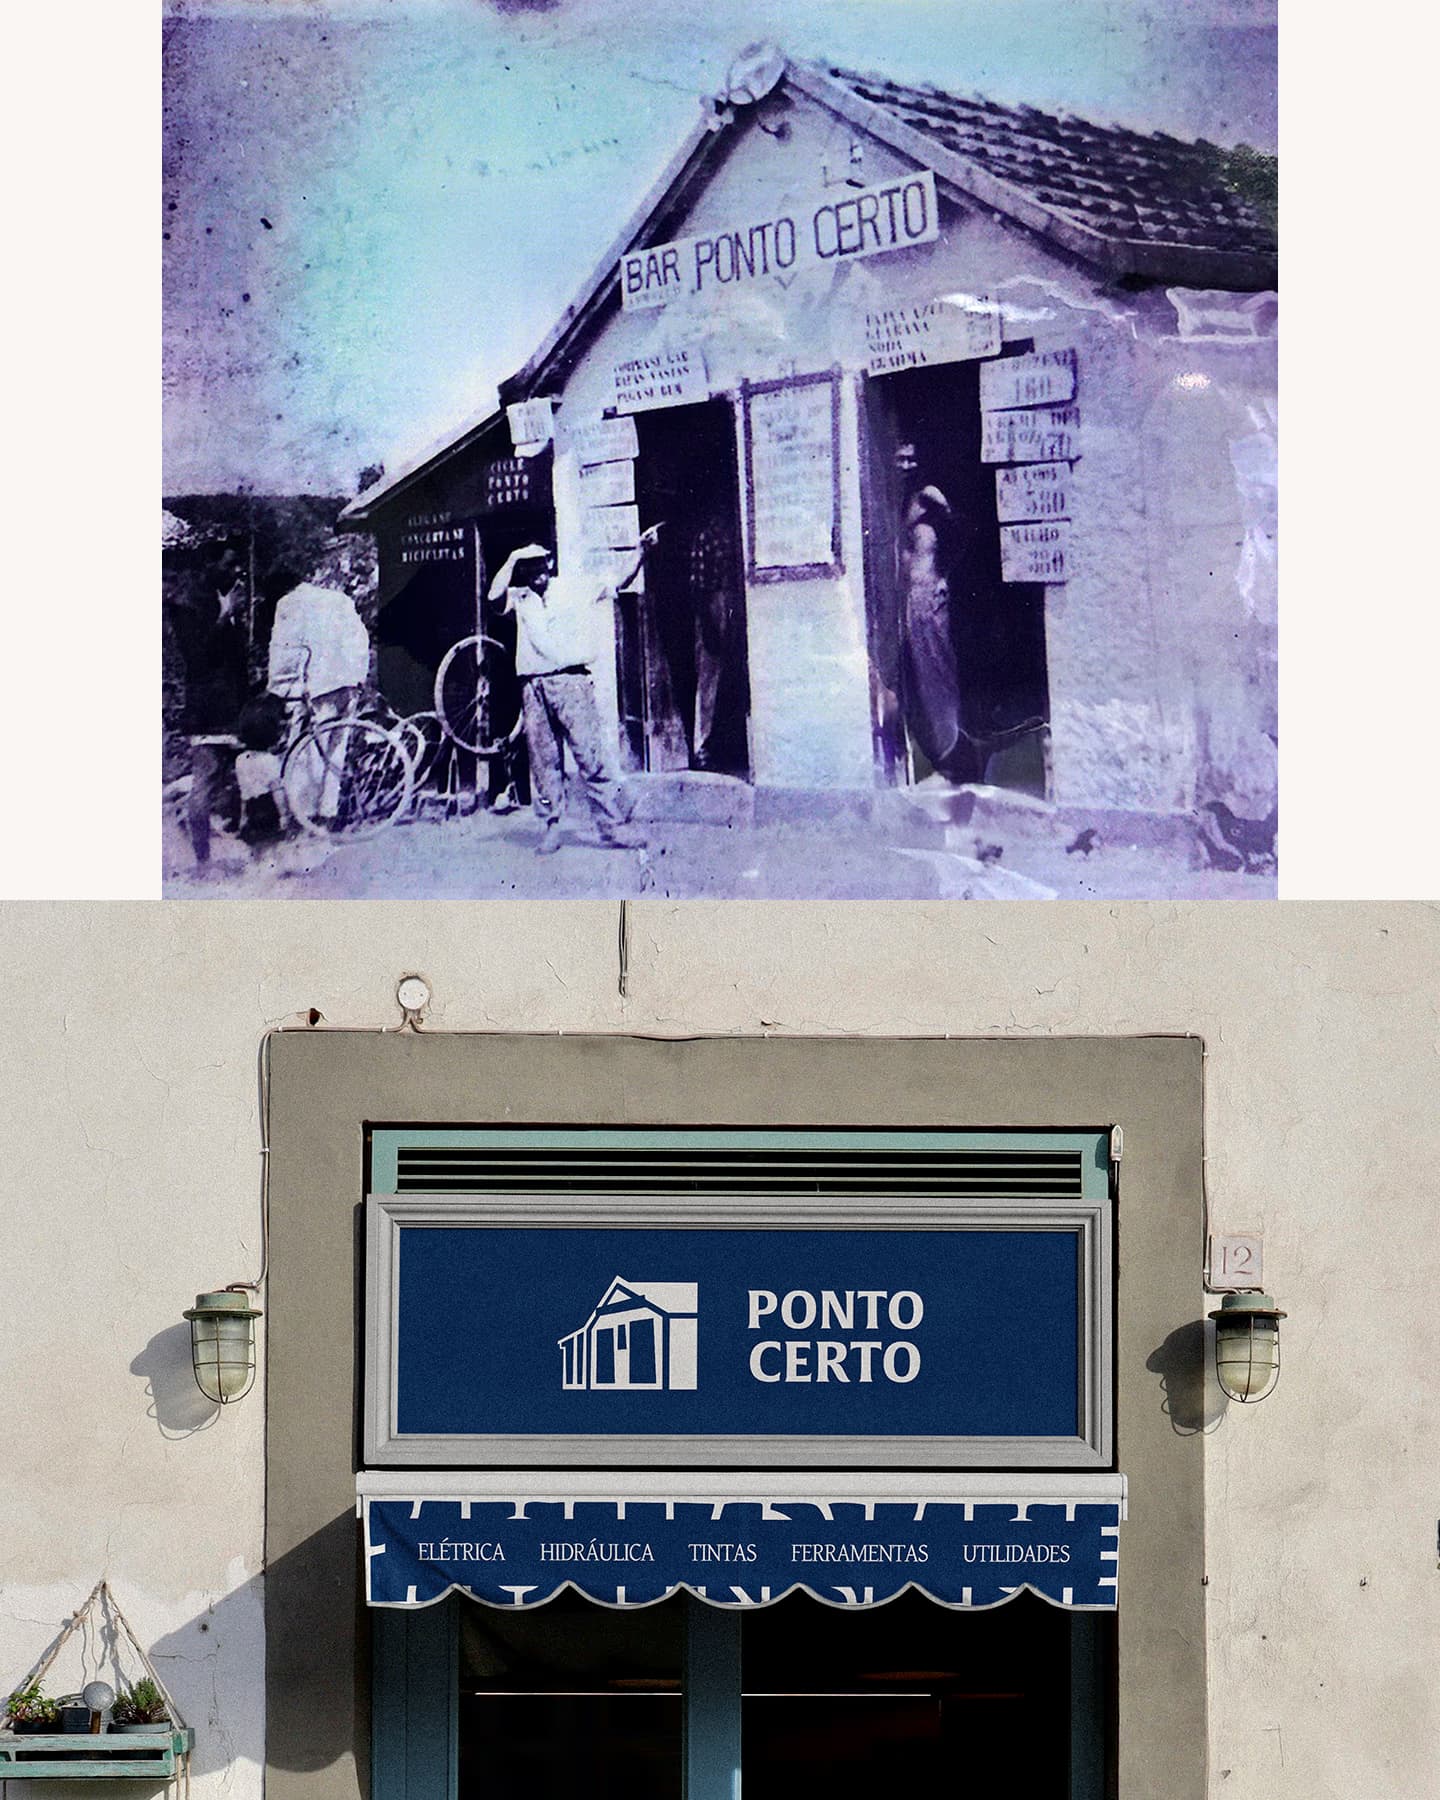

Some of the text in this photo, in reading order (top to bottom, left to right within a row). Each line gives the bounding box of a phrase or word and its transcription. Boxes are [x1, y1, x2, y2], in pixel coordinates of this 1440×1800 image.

[627, 181, 928, 293] BAR PONTO CERTO
[1223, 1246, 1253, 1274] 12
[748, 1290, 924, 1330] PONTO
[750, 1341, 921, 1383] CERTO
[418, 1537, 1071, 1563] ELÉTRICA HIDRÁULICA TINTAS FERRAMENTAS UTILIDADES
